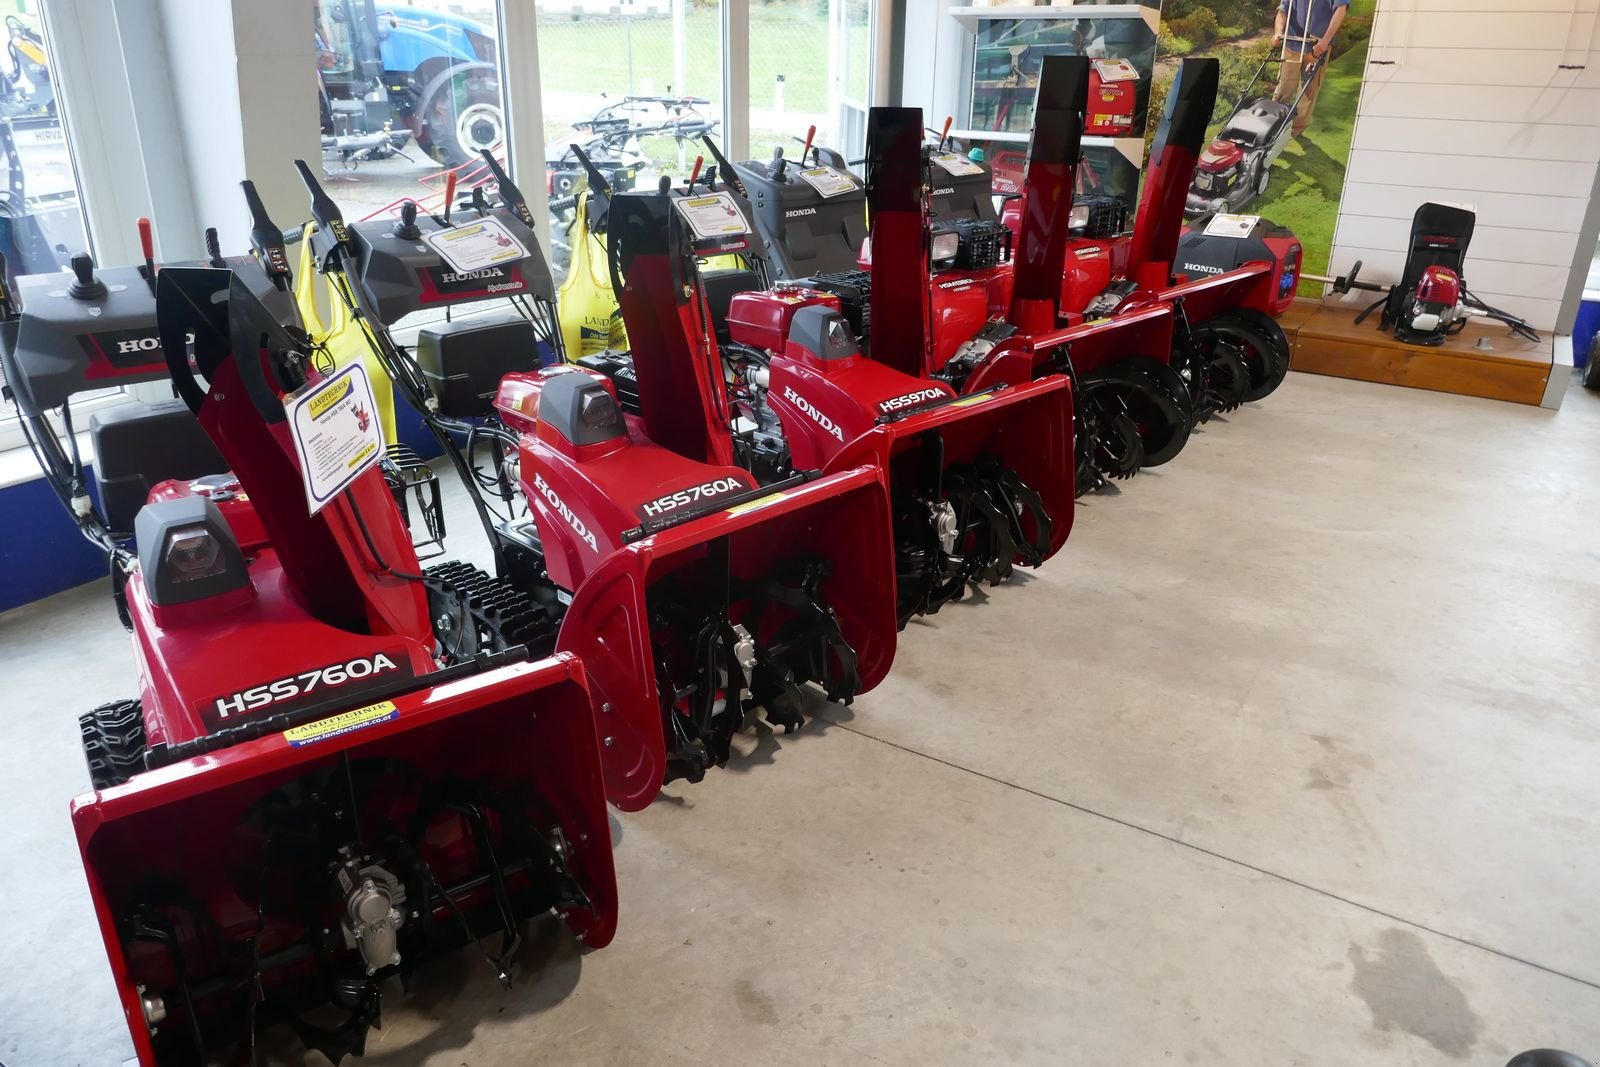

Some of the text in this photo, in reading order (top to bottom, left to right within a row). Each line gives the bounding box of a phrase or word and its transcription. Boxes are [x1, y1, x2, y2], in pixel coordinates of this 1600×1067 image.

[785, 208, 817, 218] HONDA
[441, 267, 504, 283] HONDA
[1184, 262, 1225, 275] HONDA
[309, 380, 348, 411] LANDTECHNIK
[879, 387, 946, 413] HSS970A
[783, 385, 844, 442] HONDA
[533, 472, 599, 554] HONDA
[643, 477, 742, 517] HSS760A
[216, 653, 397, 718] HSS760A
[290, 703, 388, 735] LANDTECHNIK
[299, 714, 392, 746] www.landtechnik.co.at
